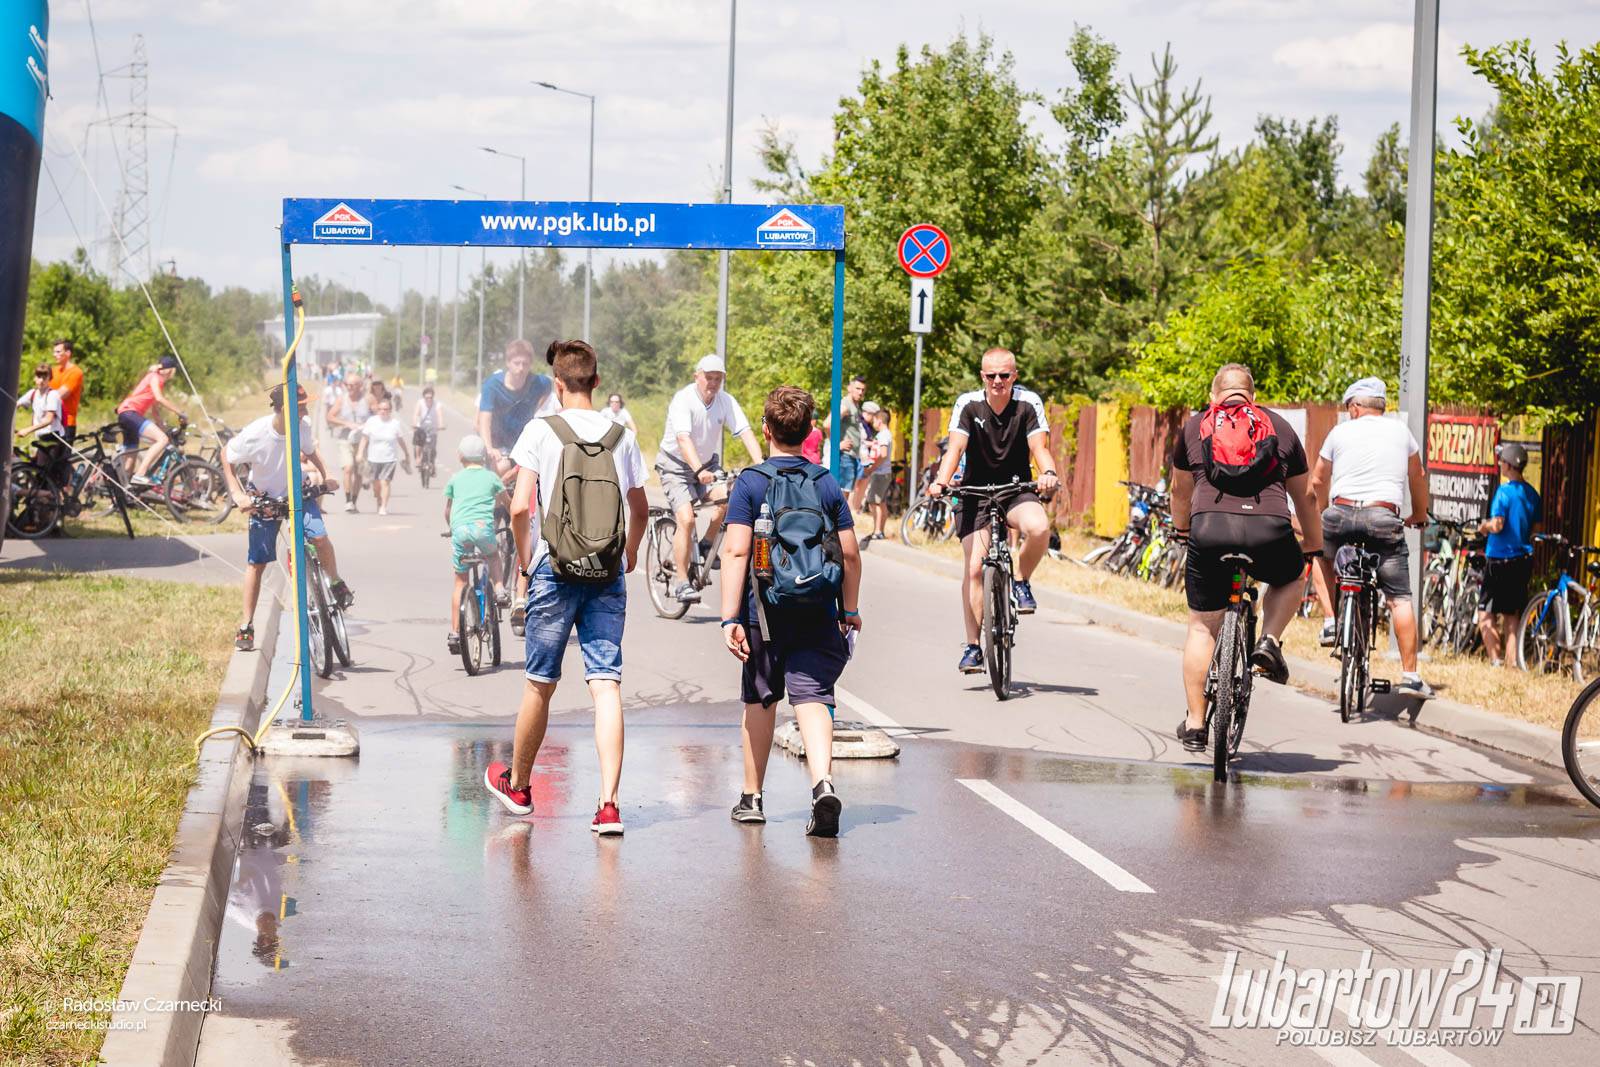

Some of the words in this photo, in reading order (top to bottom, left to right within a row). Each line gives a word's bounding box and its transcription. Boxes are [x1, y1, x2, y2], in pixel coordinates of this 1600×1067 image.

[334, 213, 351, 221] PGK
[481, 212, 656, 237] www.pgk.lub.pl
[321, 227, 366, 235] LUBARTÓW
[764, 232, 809, 240] LUBARTÓW
[566, 563, 609, 578] adidas
